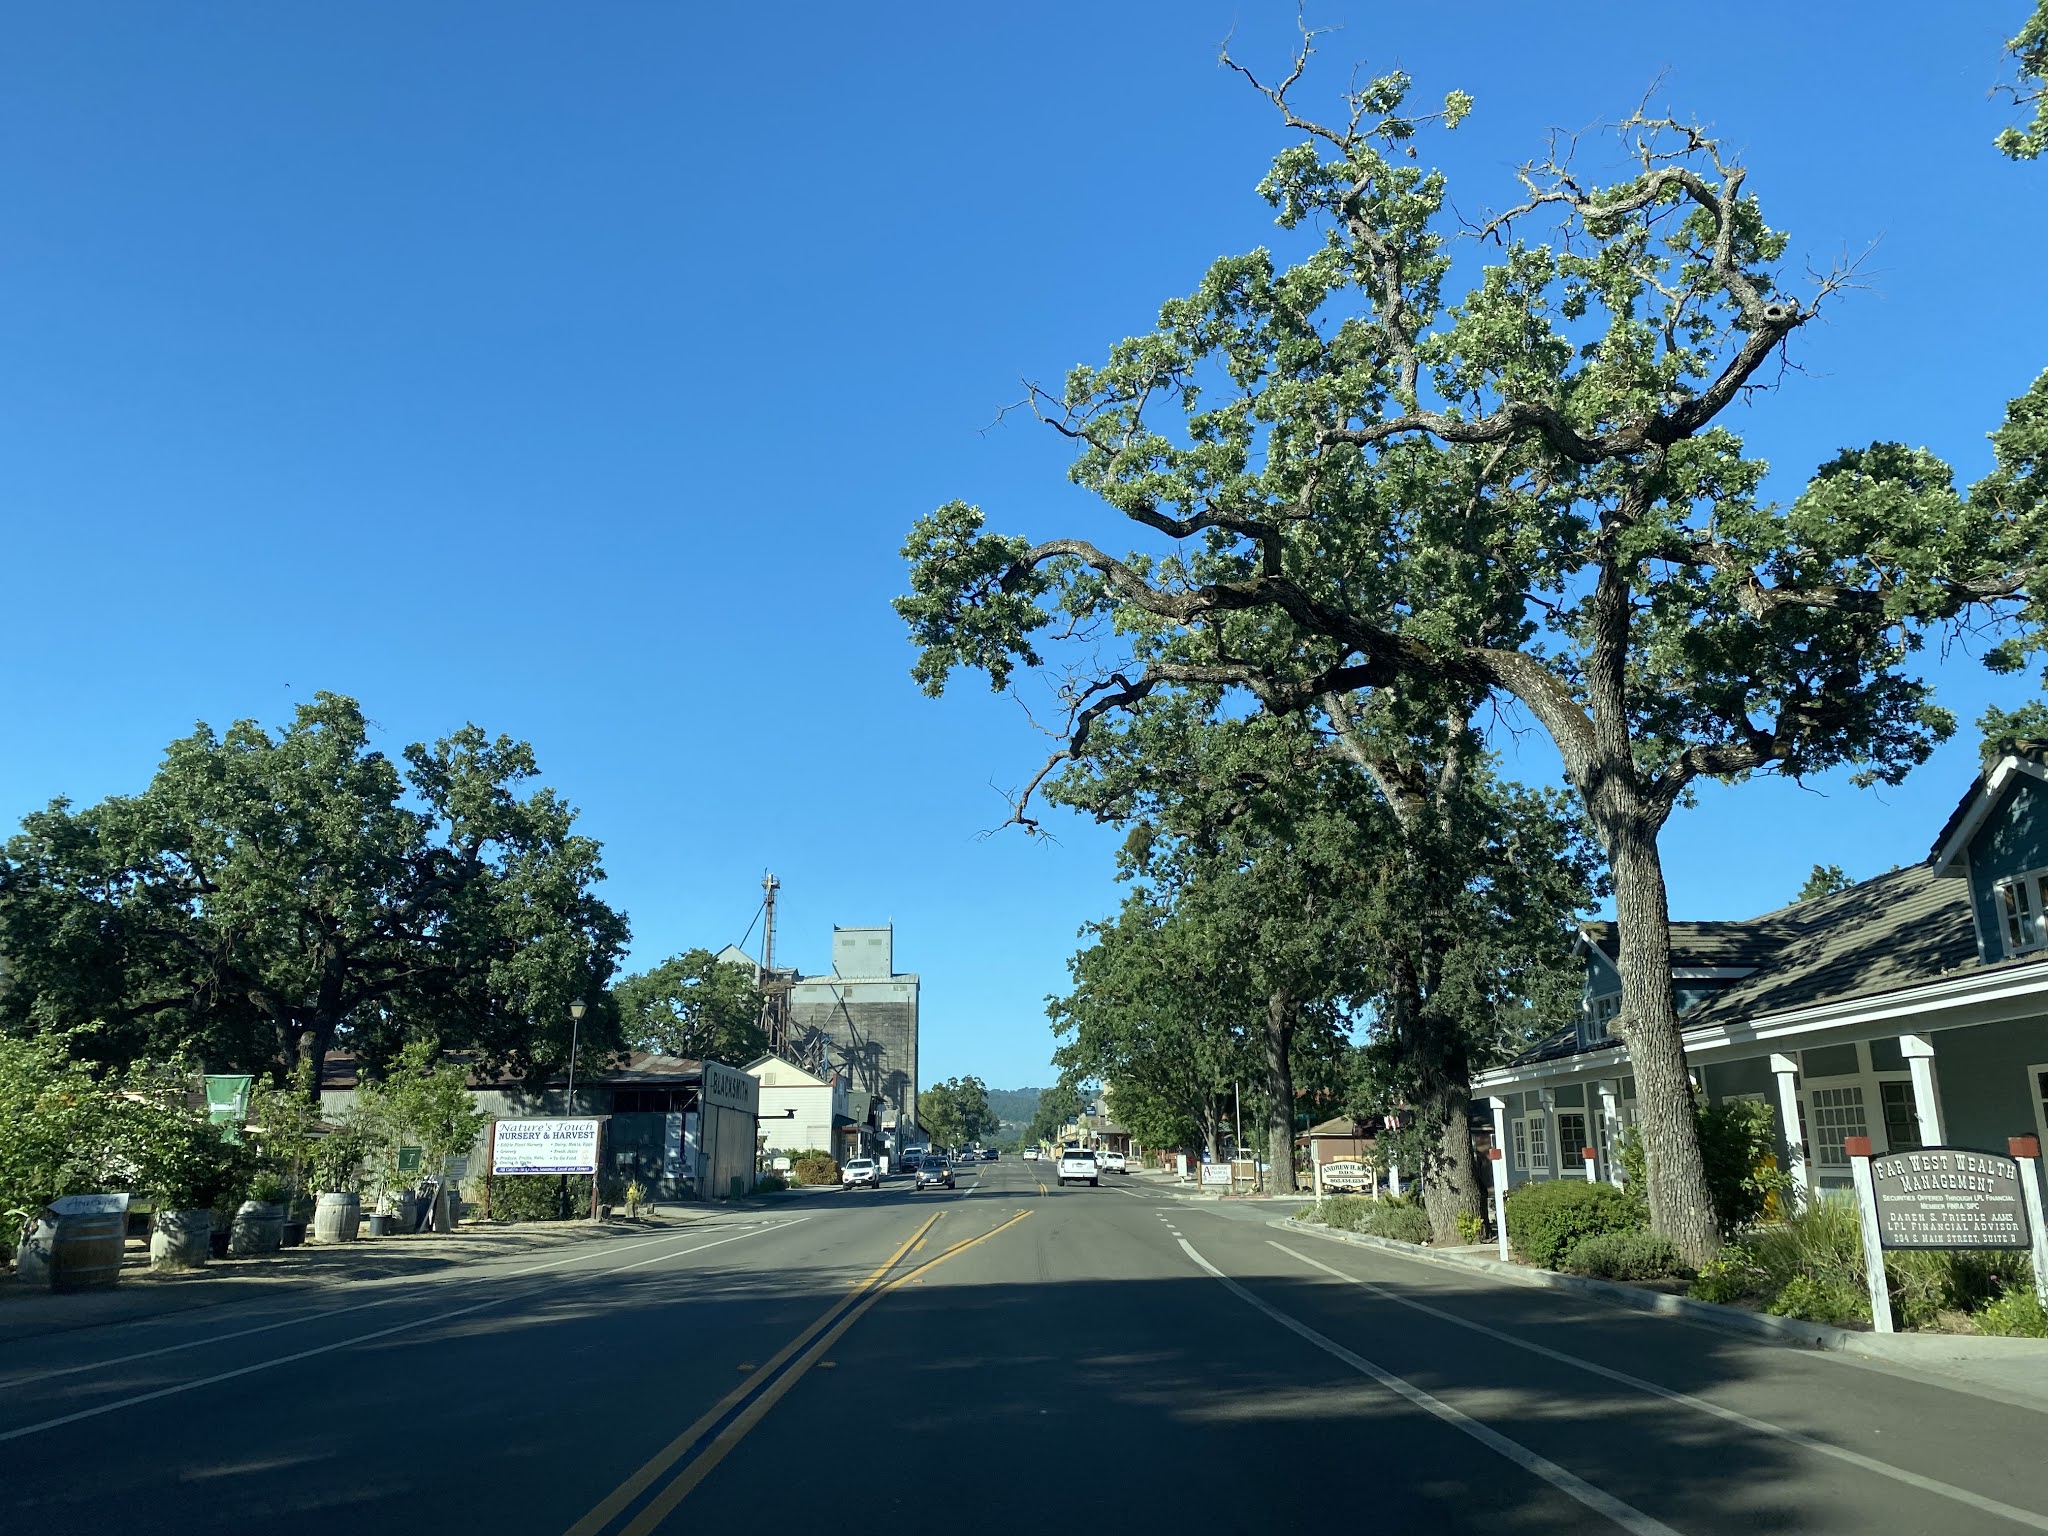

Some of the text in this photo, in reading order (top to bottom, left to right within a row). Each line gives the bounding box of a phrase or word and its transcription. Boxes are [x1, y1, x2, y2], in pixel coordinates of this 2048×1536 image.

[498, 1122, 593, 1132] Nature's Touch
[1324, 1164, 1349, 1173] ANDREW
[1875, 1154, 2016, 1180] FAR WEST WEALTH
[1900, 1174, 1994, 1193] MANAGEMENT
[1890, 1213, 1926, 1222] DAREN
[1942, 1213, 1986, 1222] FRIEDLE
[1888, 1222, 2020, 1230] LPL FINANCIAL ADVISOR
[1922, 1234, 1944, 1242] MAIN
[1947, 1234, 1980, 1244] STREET,
[1983, 1234, 2008, 1242] SUITE
